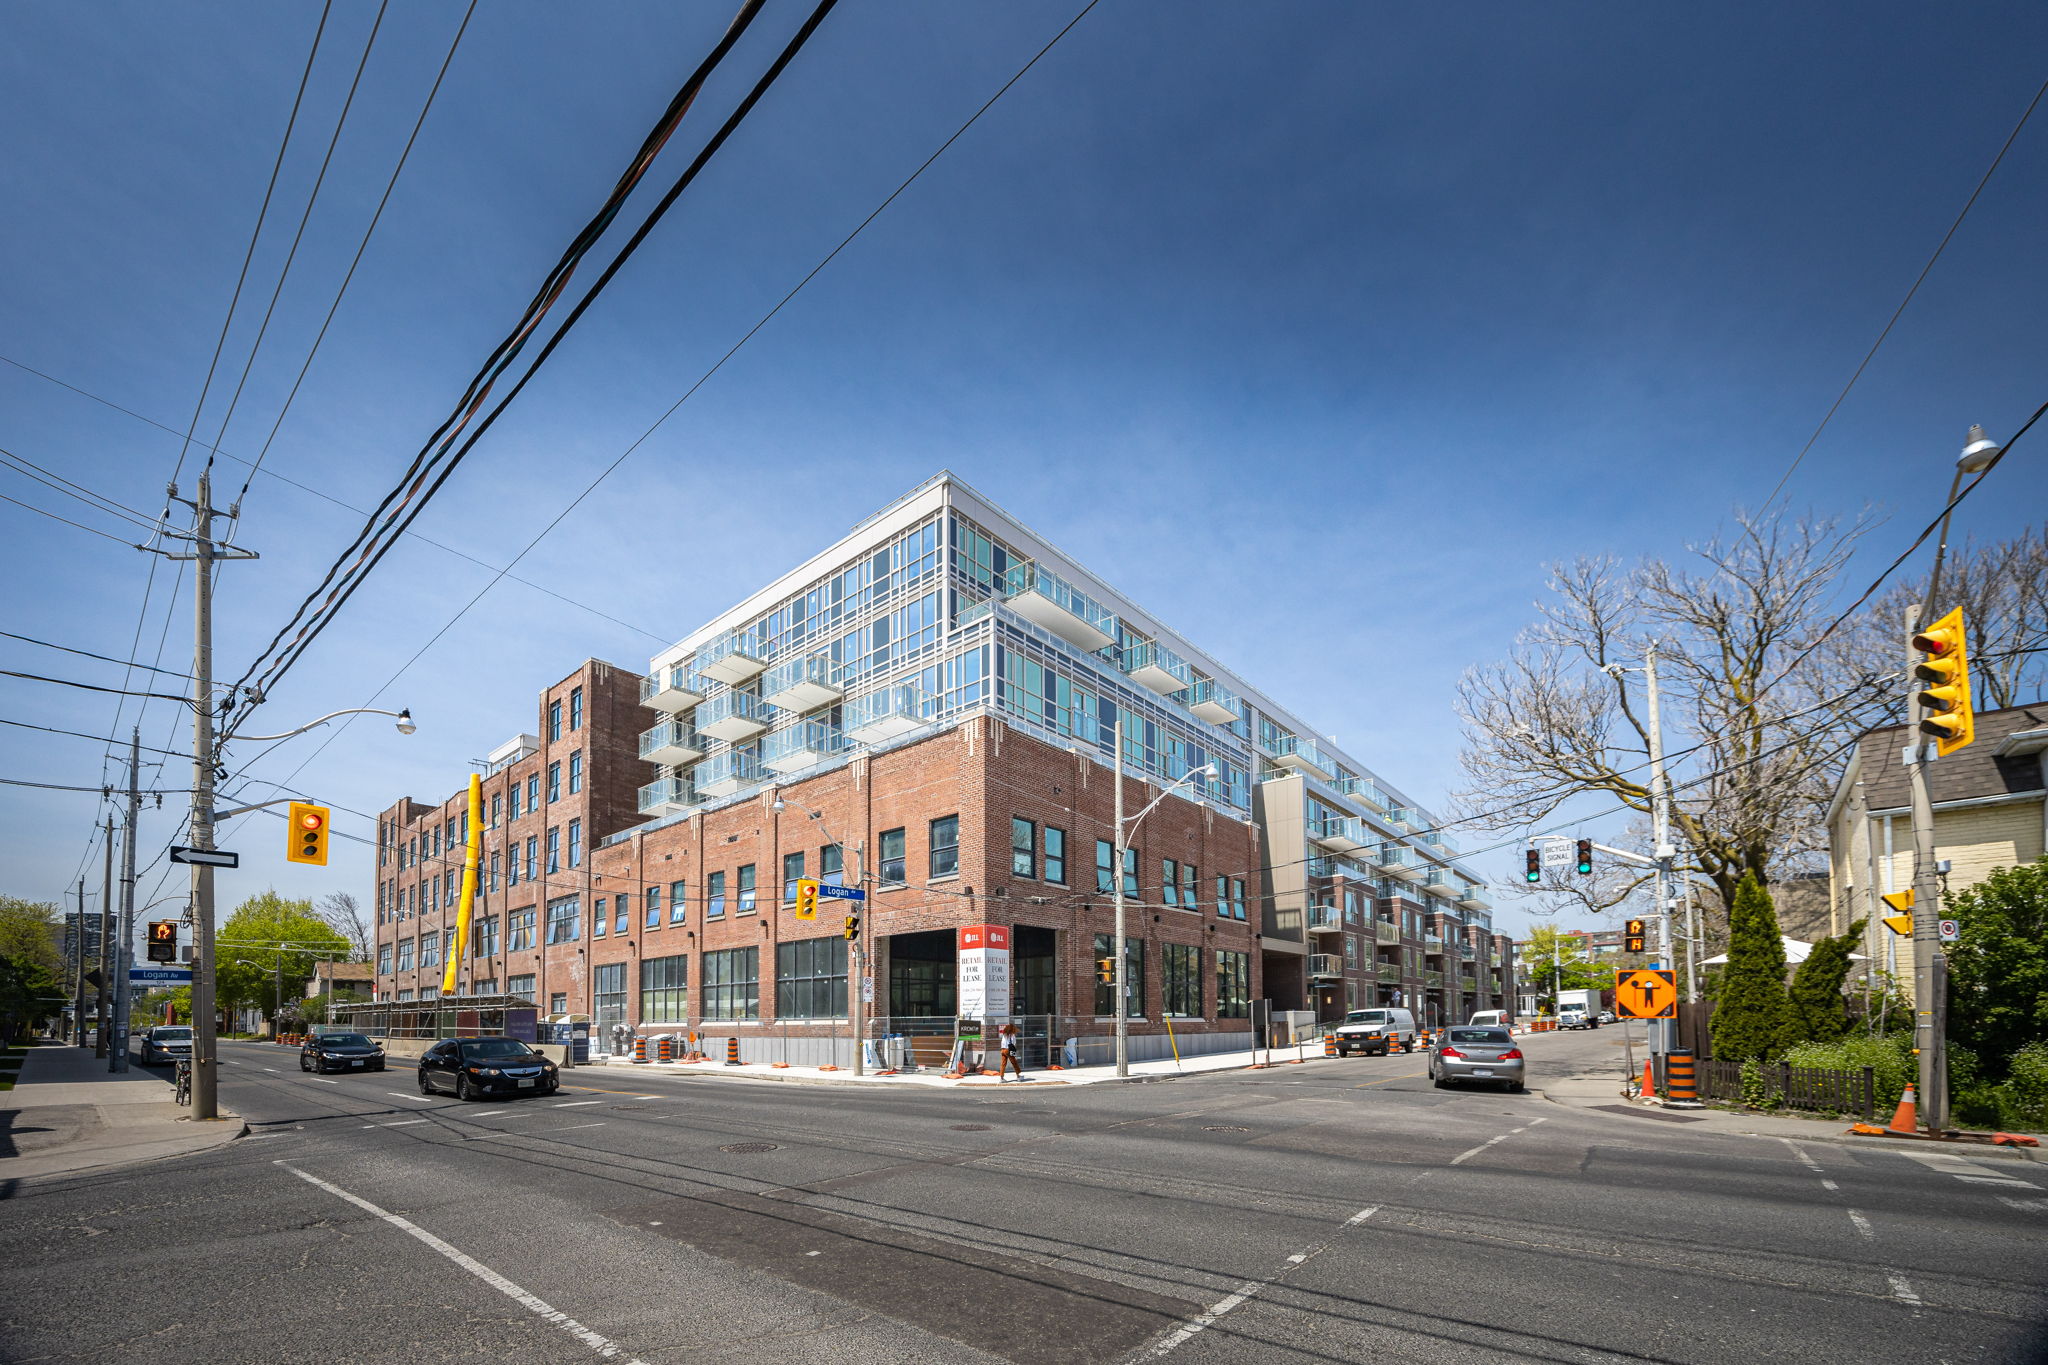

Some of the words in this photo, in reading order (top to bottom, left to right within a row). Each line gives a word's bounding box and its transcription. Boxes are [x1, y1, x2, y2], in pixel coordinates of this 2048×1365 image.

[1545, 844, 1570, 853] BICYCLE
[1547, 853, 1569, 861] SIGNAL
[827, 886, 849, 897] Logan
[961, 957, 982, 965] RETAIL
[987, 957, 1008, 965] RETAIL
[143, 970, 168, 979] Logan
[988, 974, 1007, 983] LEASE
[963, 975, 982, 983] LEASE
